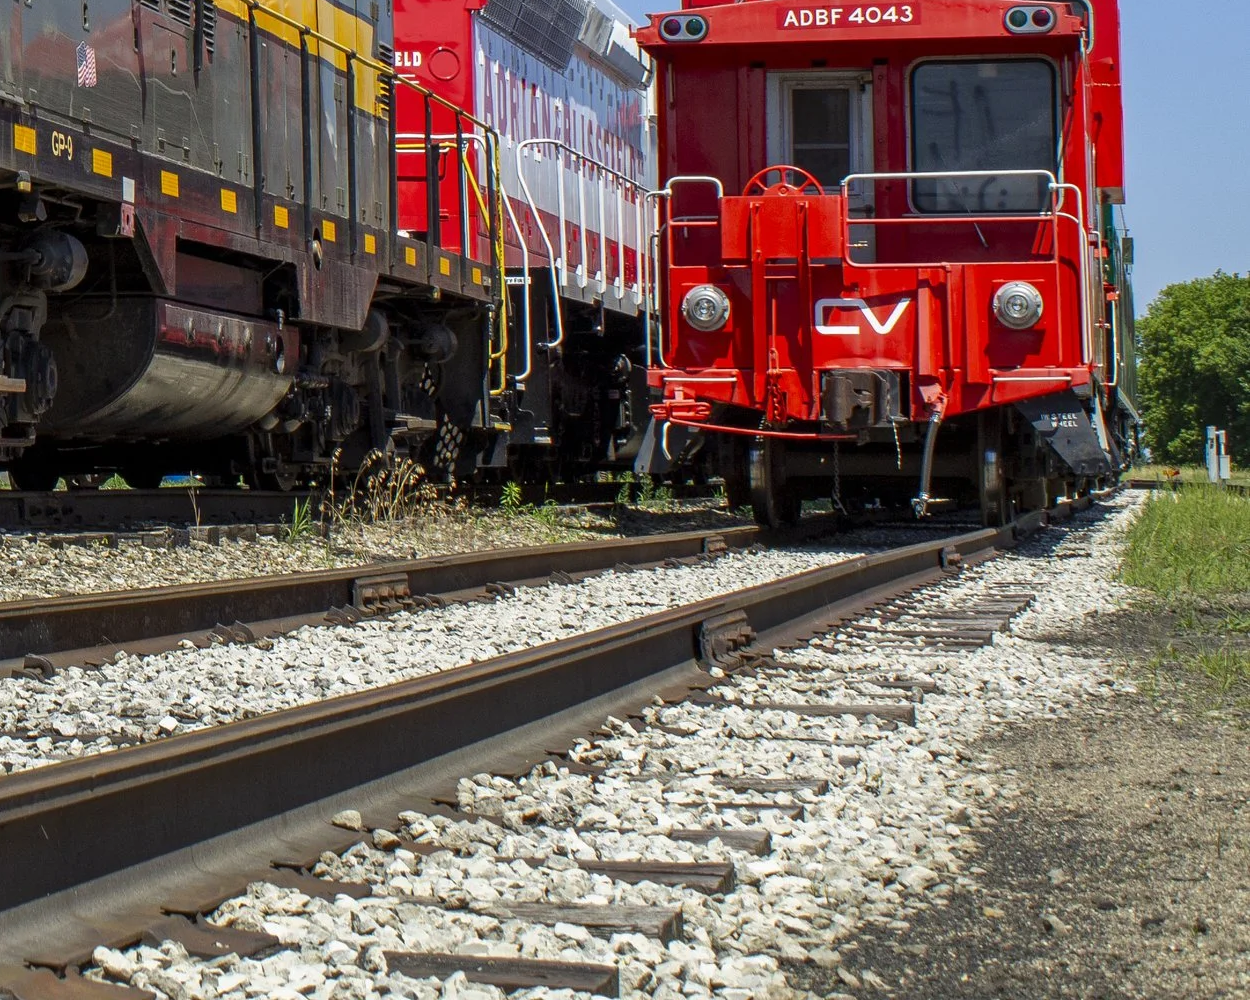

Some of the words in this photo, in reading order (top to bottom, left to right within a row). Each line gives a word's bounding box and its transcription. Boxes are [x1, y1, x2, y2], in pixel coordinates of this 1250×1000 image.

[783, 8, 844, 28] ADBF
[848, 5, 914, 24] 4043
[483, 54, 553, 161] ADRIAN
[51, 130, 73, 161] GP-9
[814, 298, 911, 335] CV
